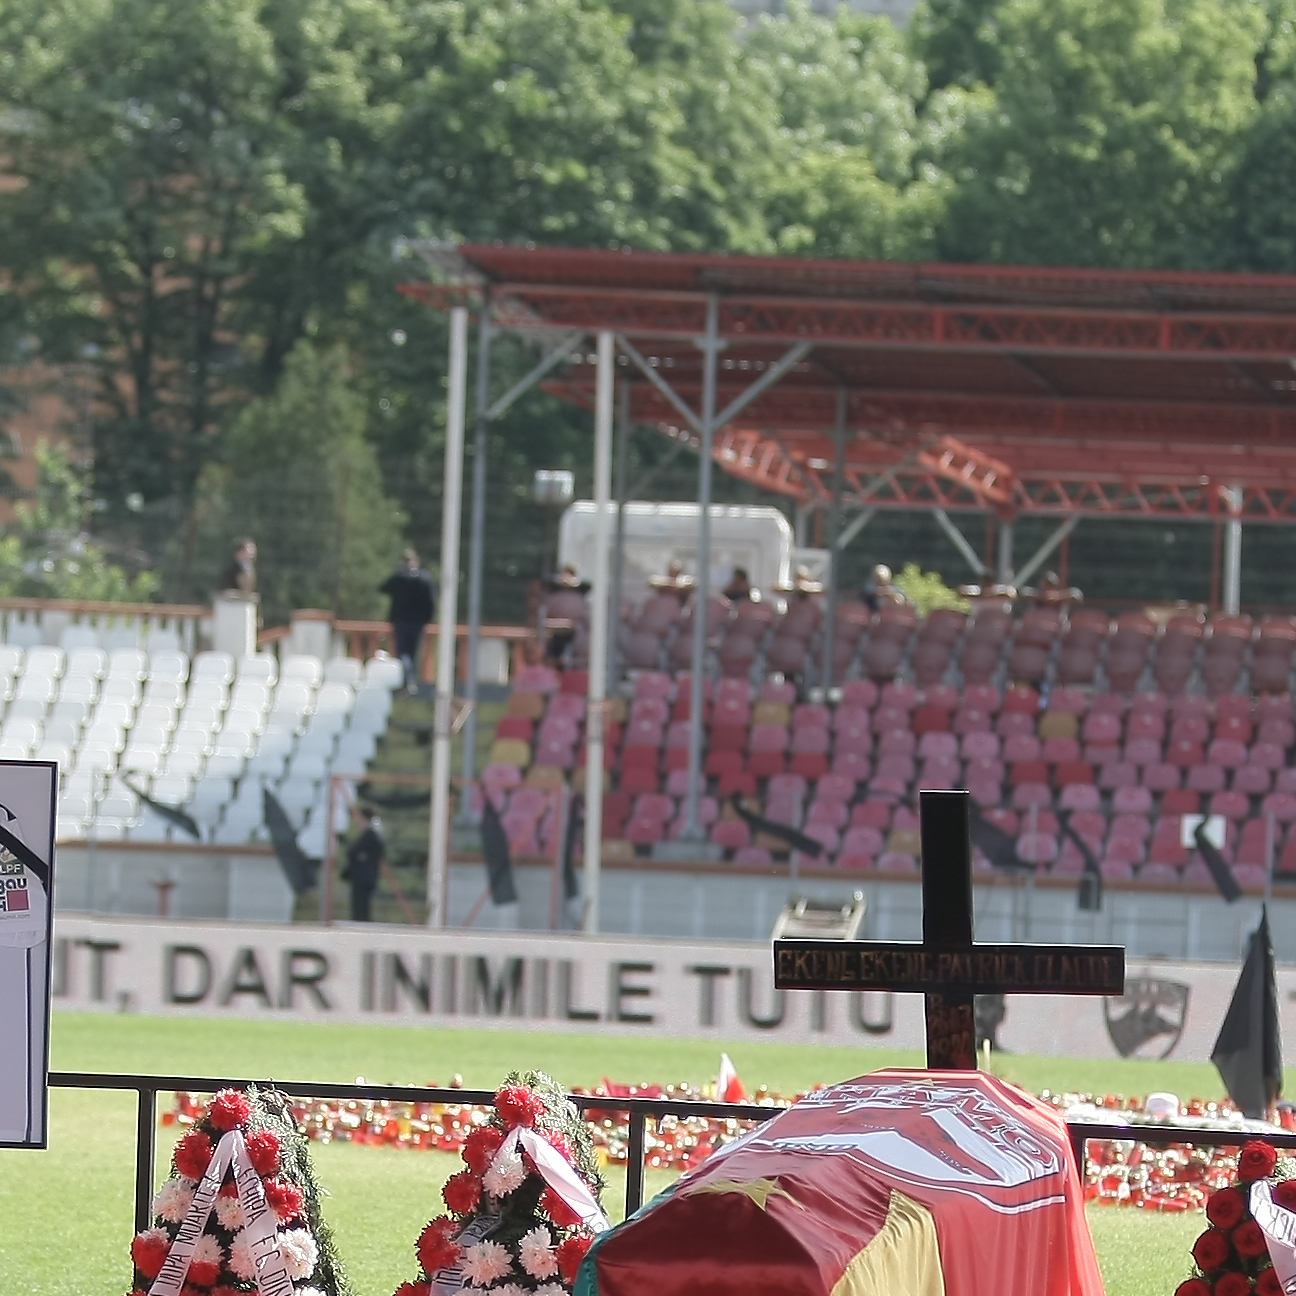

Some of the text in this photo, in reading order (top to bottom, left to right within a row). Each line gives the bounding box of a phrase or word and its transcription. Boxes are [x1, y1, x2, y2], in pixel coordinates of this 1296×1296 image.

[0, 863, 21, 874] LPF
[161, 943, 333, 1010] DAR
[360, 949, 654, 1023] INIMILE
